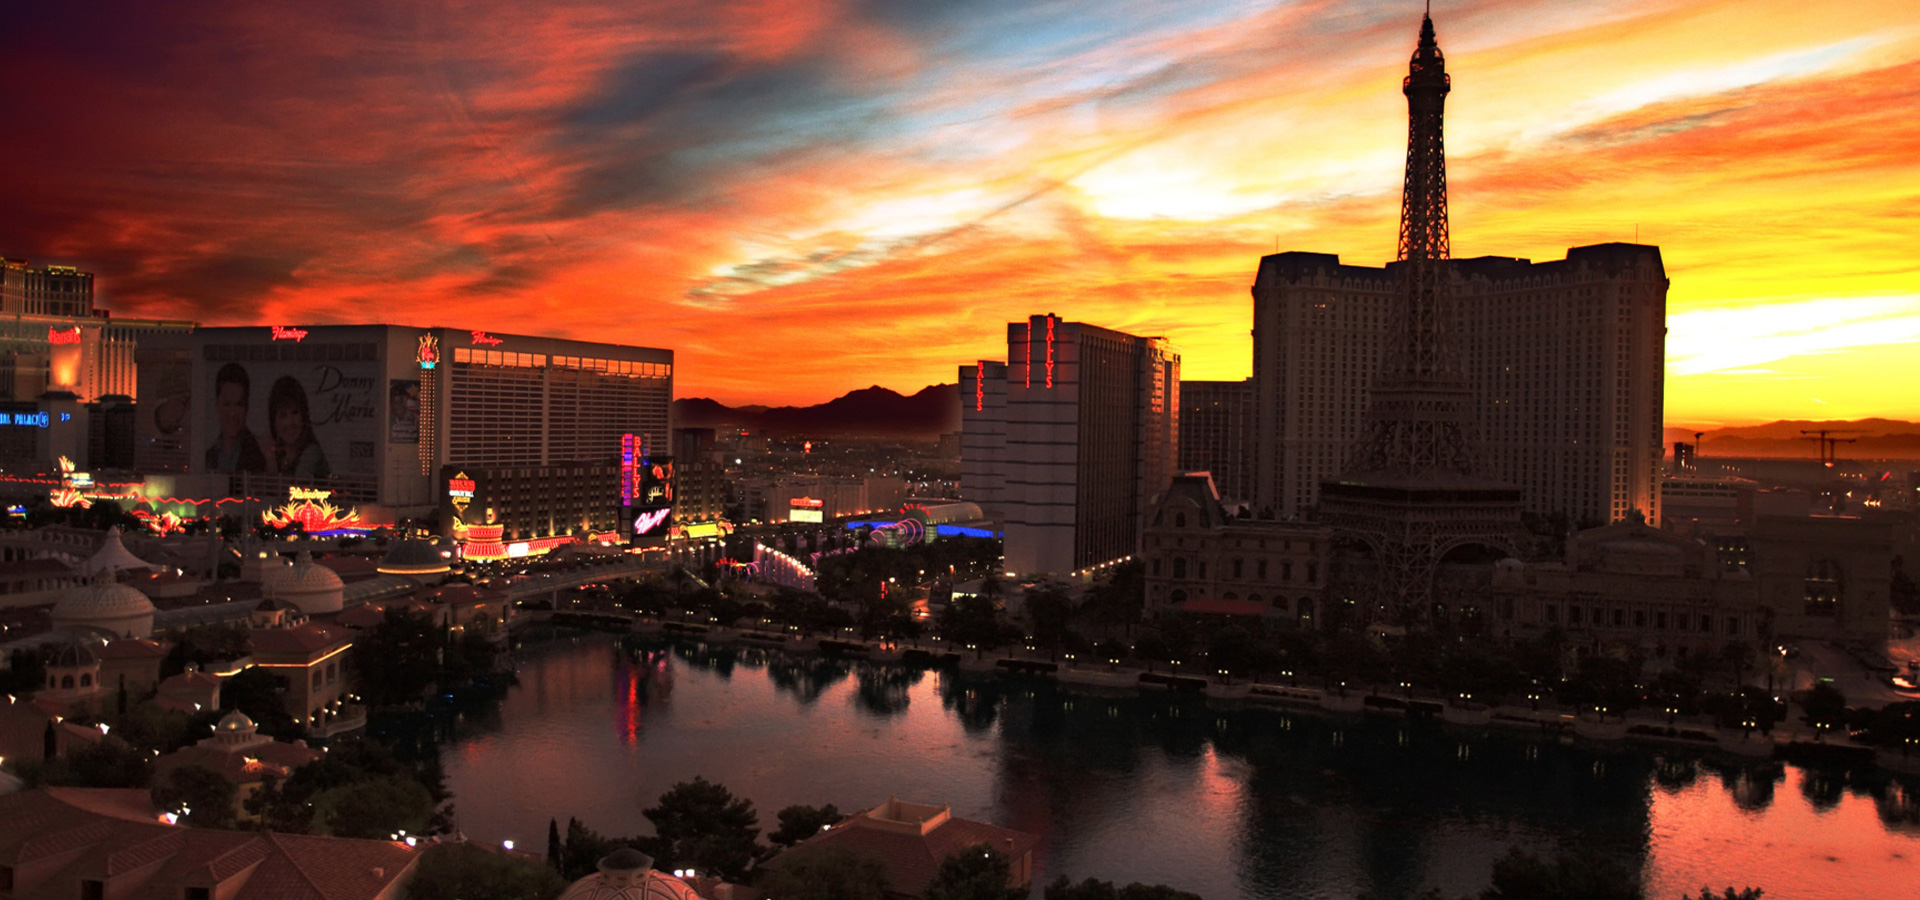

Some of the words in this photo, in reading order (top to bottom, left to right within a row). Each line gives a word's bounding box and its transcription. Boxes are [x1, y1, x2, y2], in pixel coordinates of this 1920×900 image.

[271, 326, 309, 343] Flamingo
[471, 331, 504, 347] Flamingo
[312, 365, 376, 395] Donny
[310, 392, 377, 426] Marie
[632, 435, 642, 499] BALLYS
[289, 486, 331, 503] Flamingo
